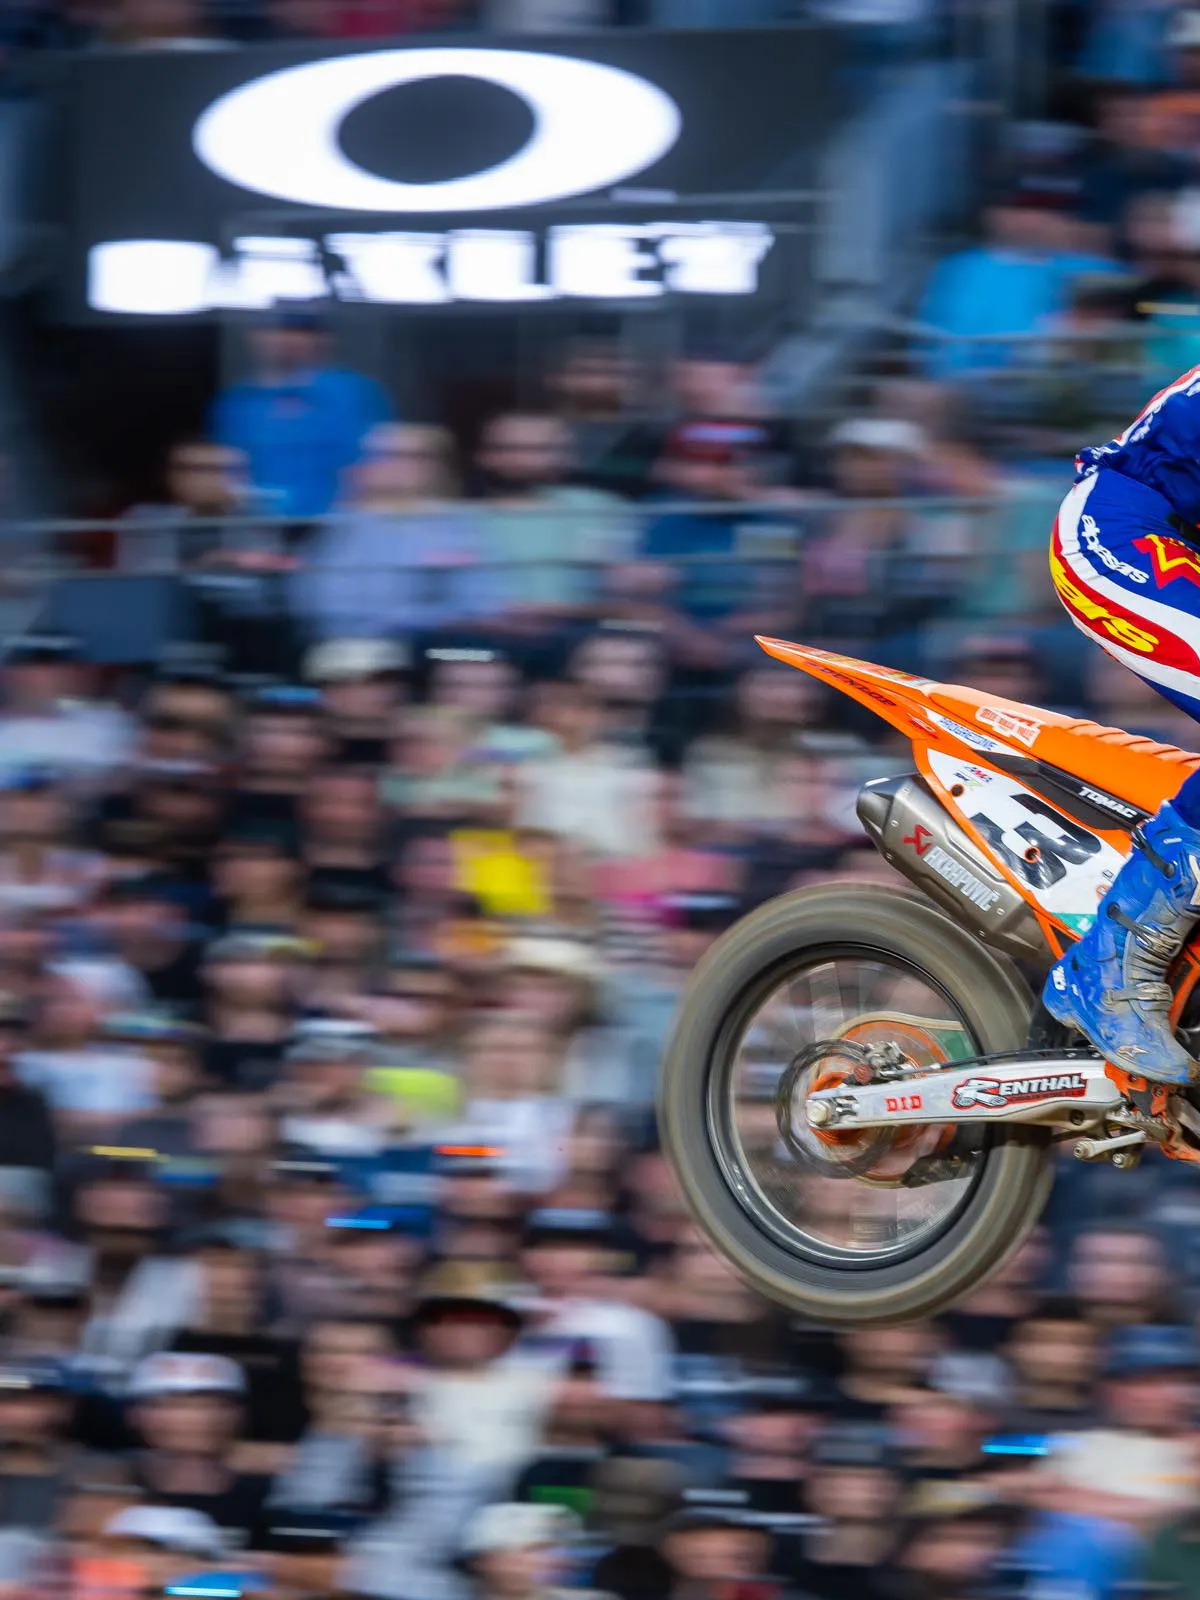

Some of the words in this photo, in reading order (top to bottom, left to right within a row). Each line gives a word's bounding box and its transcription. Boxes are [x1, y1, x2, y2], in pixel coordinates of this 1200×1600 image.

[1077, 786, 1139, 819] TOMAC
[968, 793, 1102, 890] 3
[954, 1076, 1086, 1108] RENTHAL
